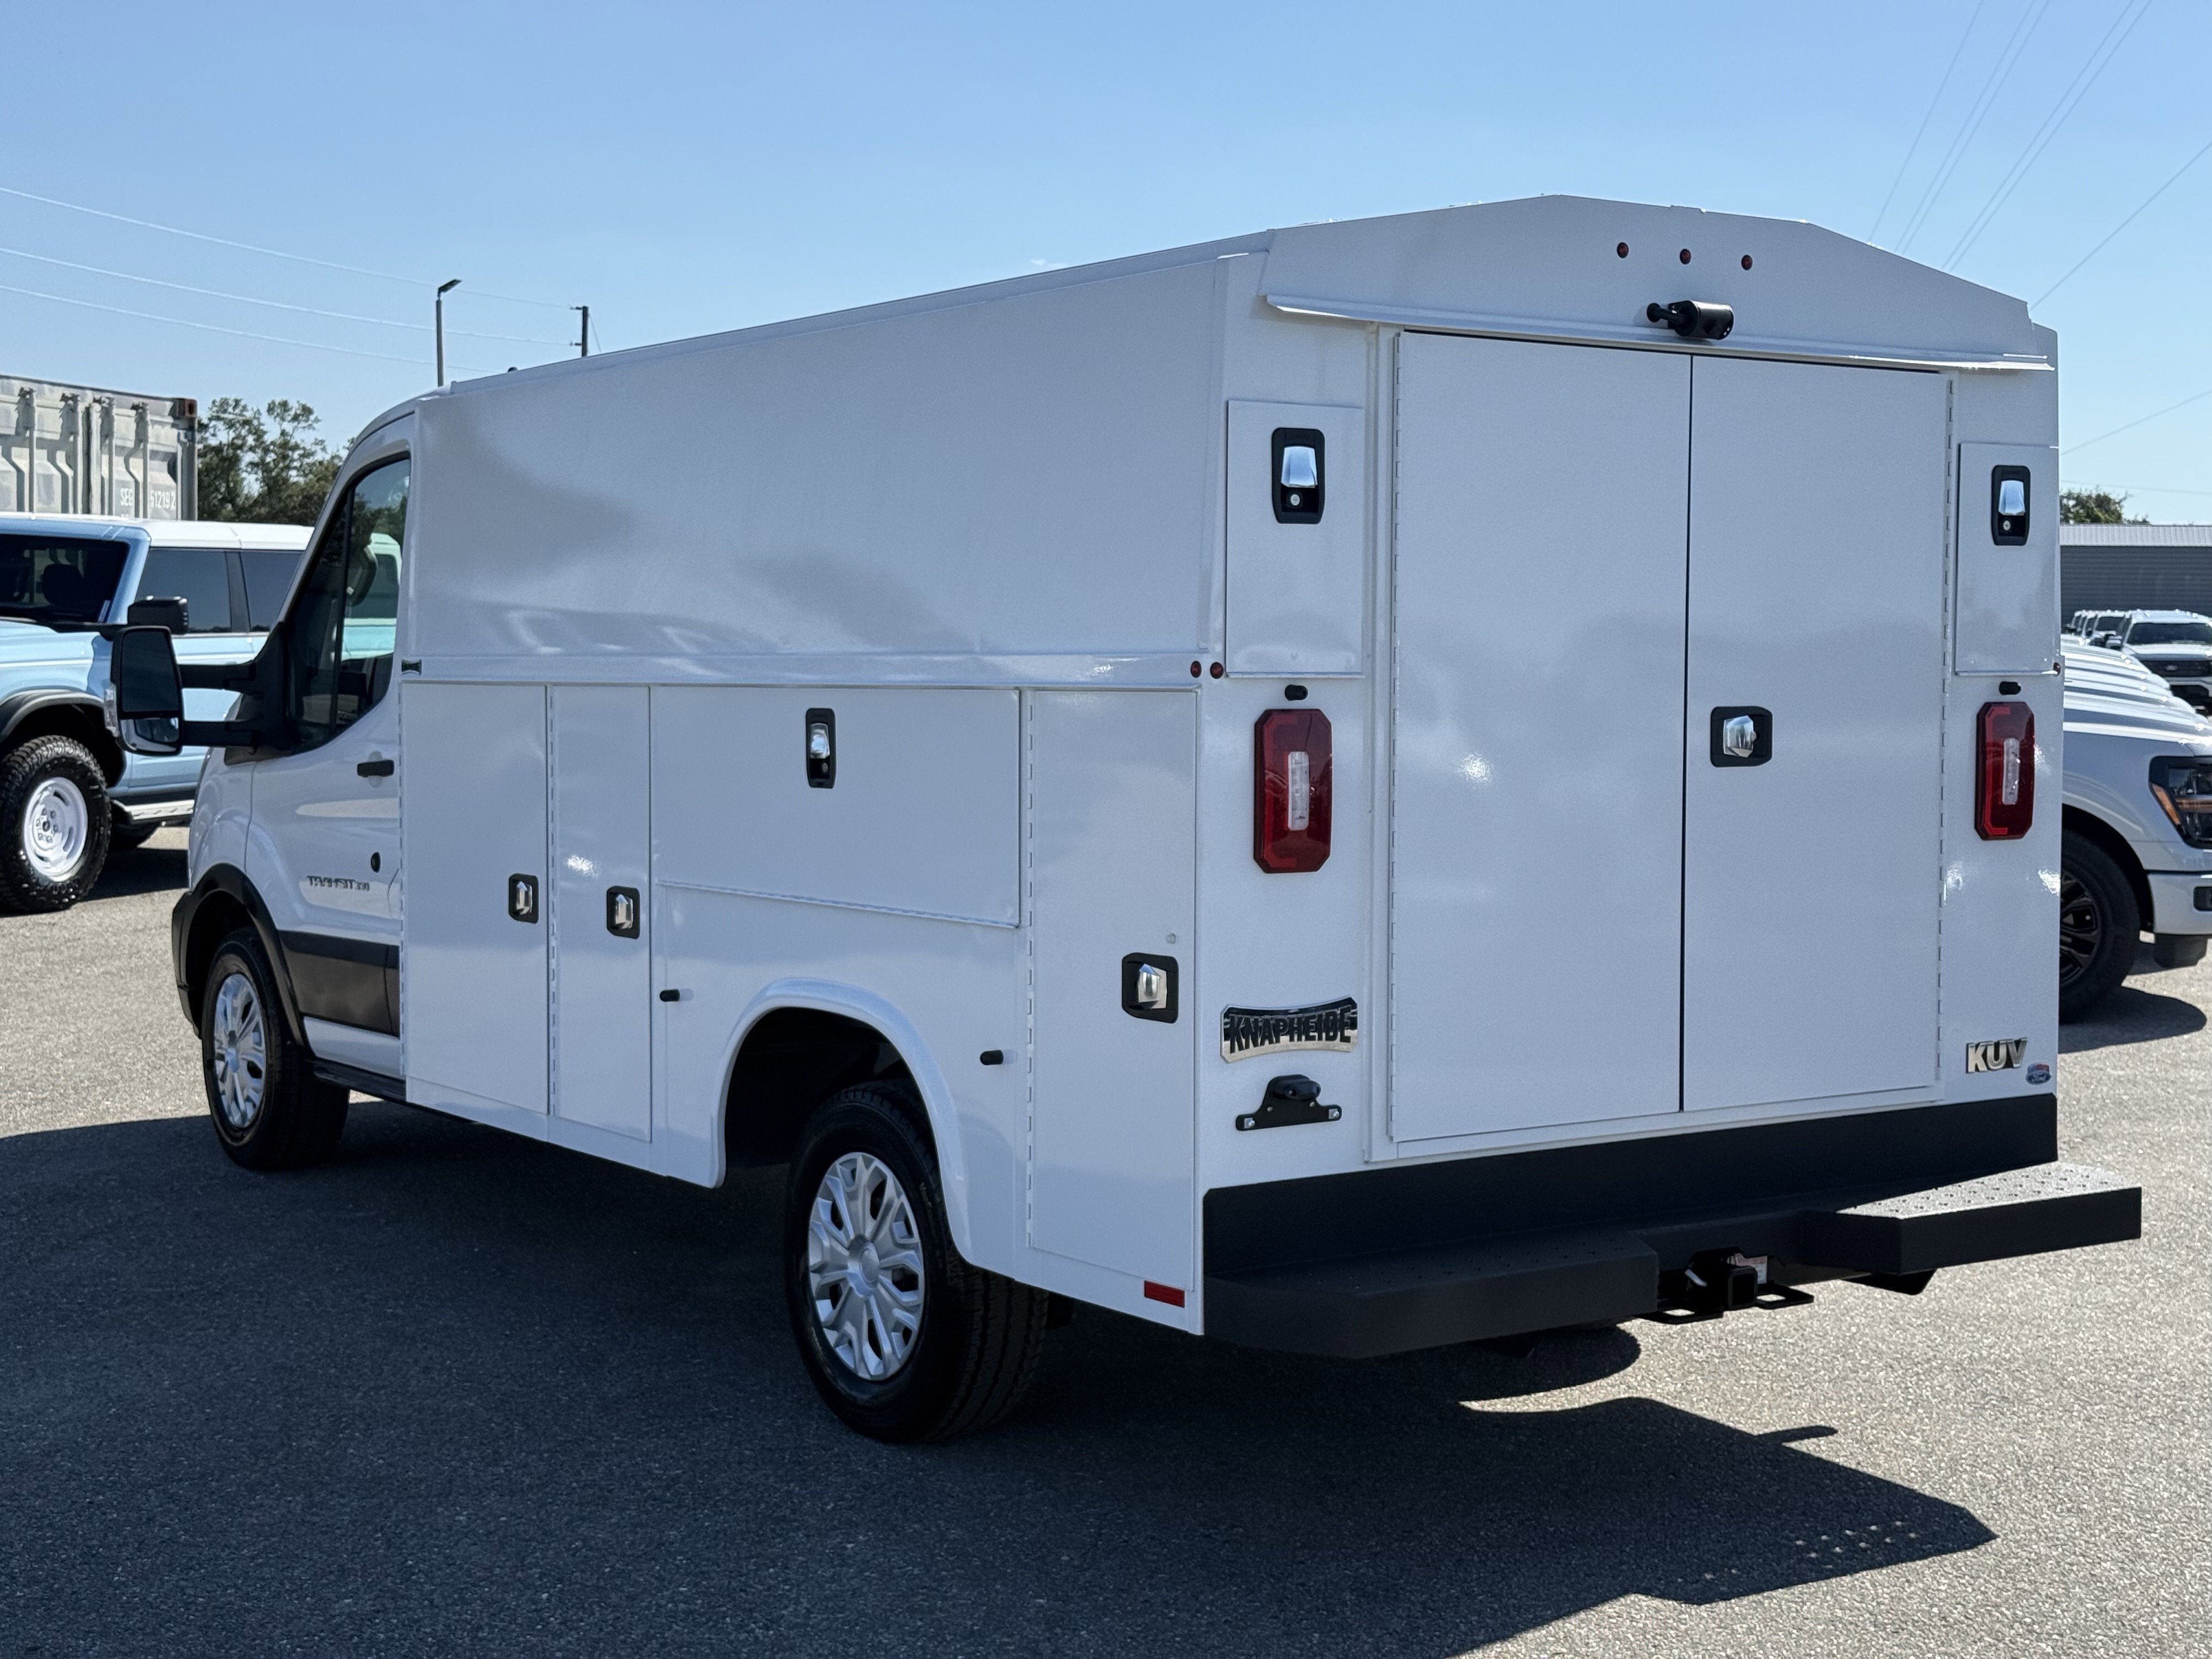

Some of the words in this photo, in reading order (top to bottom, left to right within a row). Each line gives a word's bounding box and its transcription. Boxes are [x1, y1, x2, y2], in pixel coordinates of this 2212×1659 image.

[307, 876, 356, 889] TRANSIT
[1229, 1005, 1353, 1054] KNAPHEIDE
[1966, 1037, 2028, 1074] KUV
